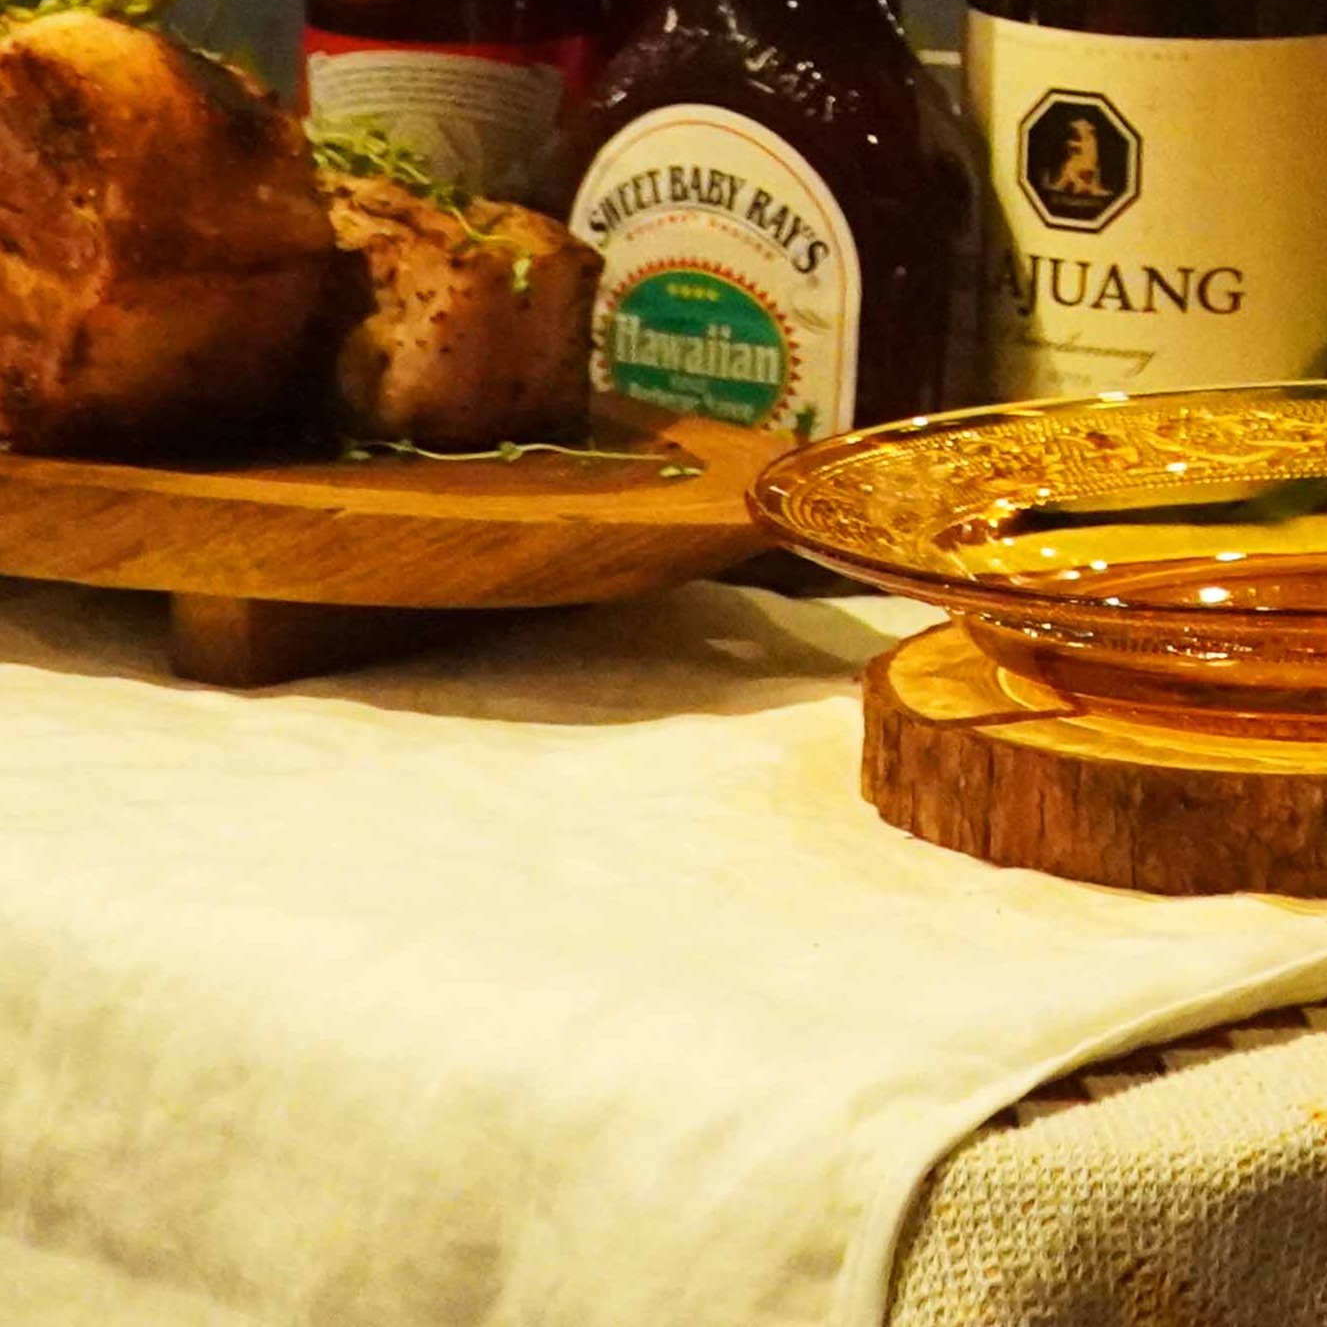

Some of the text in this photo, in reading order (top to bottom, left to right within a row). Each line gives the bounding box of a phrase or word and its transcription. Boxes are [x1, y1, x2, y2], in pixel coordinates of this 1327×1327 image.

[588, 168, 663, 249] SWEET
[668, 164, 748, 211] BABY
[745, 187, 830, 274] RAY'S
[614, 311, 781, 386] Hawaiian
